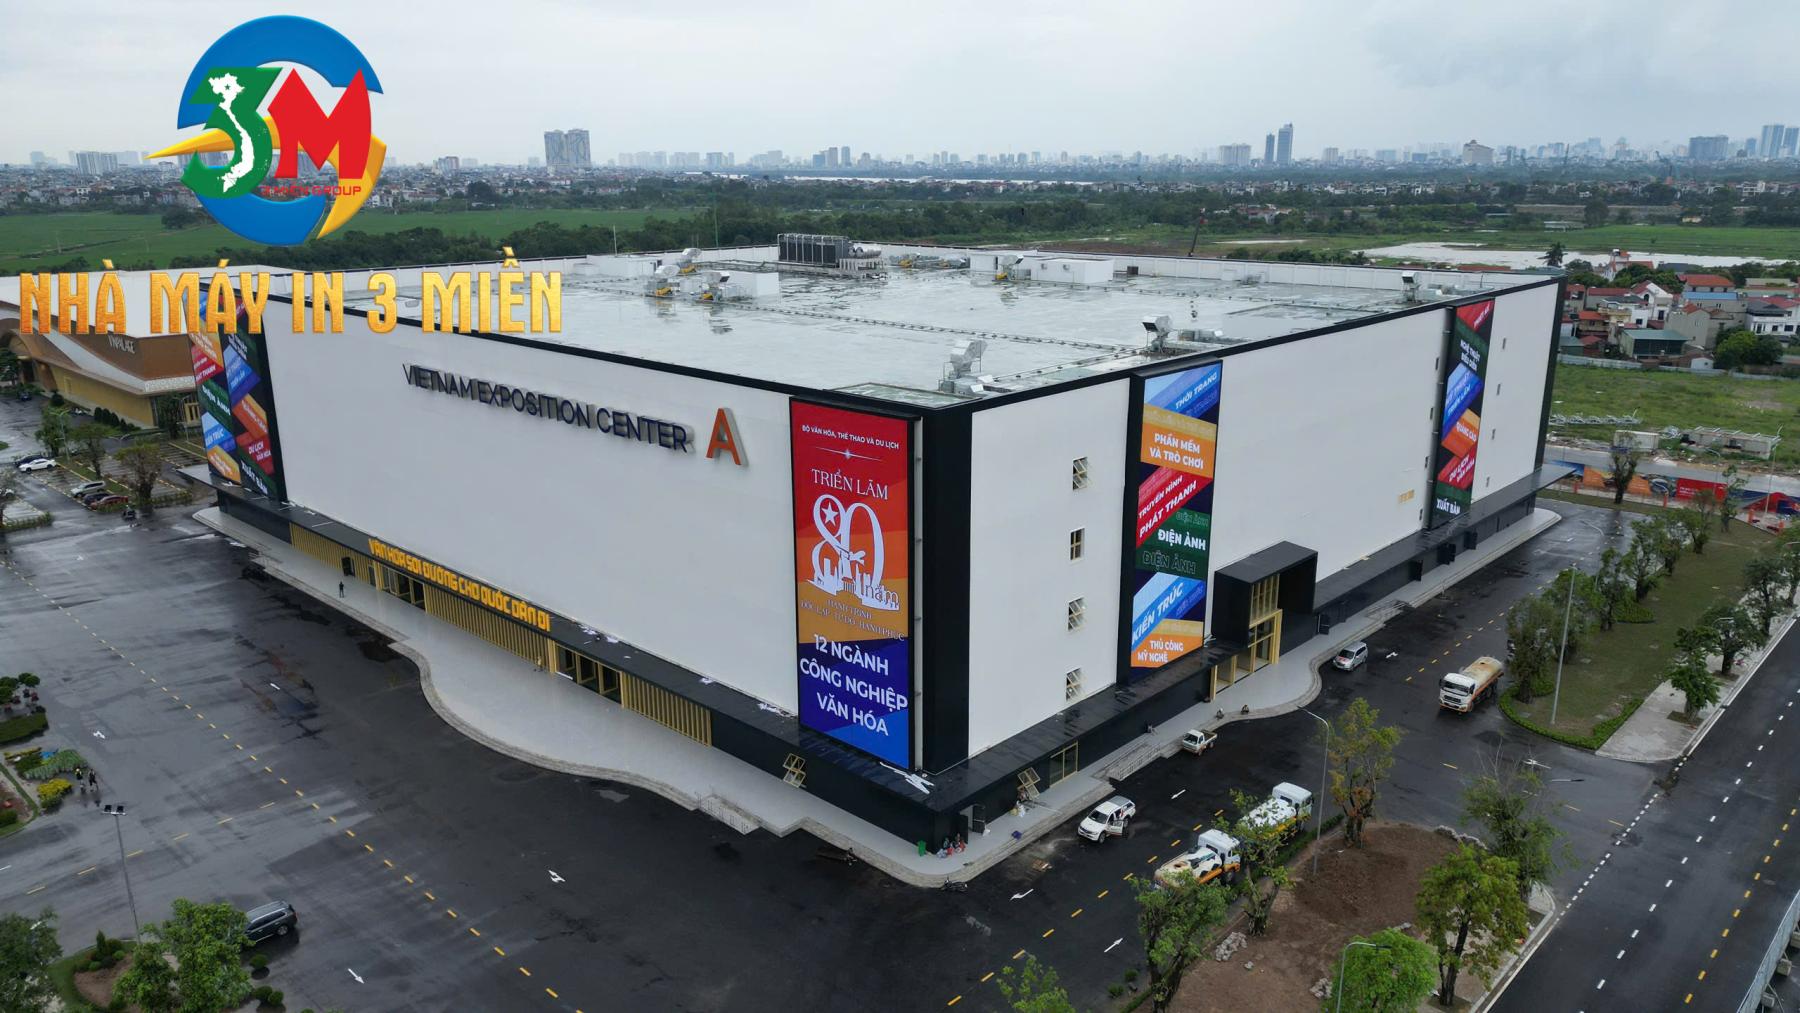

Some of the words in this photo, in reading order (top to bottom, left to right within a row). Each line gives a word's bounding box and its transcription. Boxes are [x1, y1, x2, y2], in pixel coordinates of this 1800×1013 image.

[1193, 371, 1218, 395] TRANG
[403, 363, 476, 401] VIETNAM
[478, 380, 592, 429] EXPOSITION
[597, 408, 691, 453] CENTER
[706, 407, 746, 466] A
[849, 434, 866, 443] THAO
[866, 437, 875, 446] VÀ
[875, 440, 885, 448] DU
[886, 442, 899, 451] LỊCH
[1154, 432, 1179, 448] PHẦN
[1181, 439, 1200, 455] MỀM
[1149, 446, 1162, 459] VÀ
[1164, 449, 1181, 463] TRÒ
[1182, 456, 1204, 470] CHƠI
[811, 468, 853, 493] TRIỂN
[857, 479, 889, 500] LÃM
[1139, 508, 1163, 538] PHÁT
[1165, 479, 1197, 512] THANH
[1158, 529, 1182, 546] ĐIỆN
[1184, 532, 1206, 550] ẢNH
[459, 576, 480, 601] CHO
[1157, 582, 1184, 617] TRÚC
[814, 633, 828, 653] 12
[831, 641, 889, 676] NGÀNH
[1138, 649, 1149, 661] MỸ
[1150, 638, 1164, 650] THỦ
[1164, 640, 1184, 652] CÔNG
[800, 658, 842, 688] CÔNG
[845, 675, 908, 712] NGHIỆP
[817, 692, 849, 720] VĂN
[852, 707, 889, 736] HÓA
